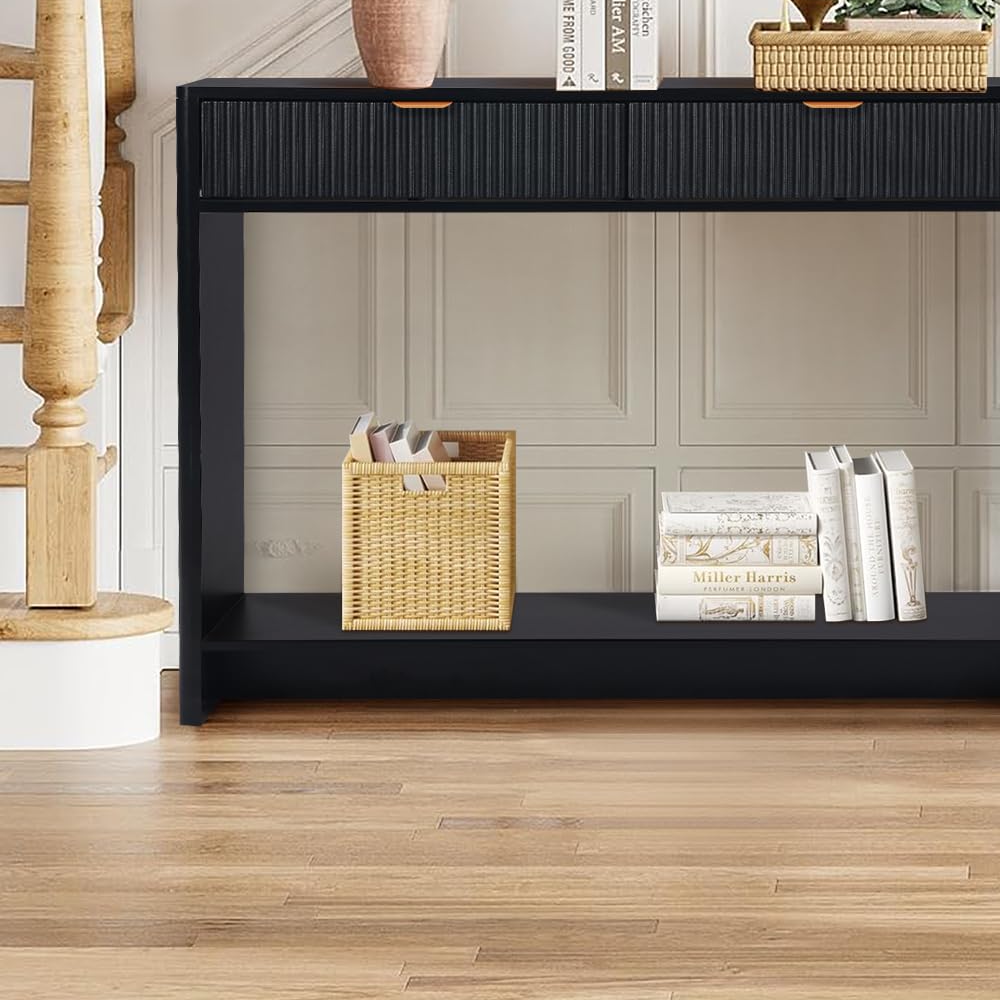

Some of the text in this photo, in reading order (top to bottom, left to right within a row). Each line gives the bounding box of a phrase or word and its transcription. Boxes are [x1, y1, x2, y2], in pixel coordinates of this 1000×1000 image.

[562, 15, 575, 43] FROM
[611, 25, 626, 53] AM
[562, 46, 575, 73] GOOD
[693, 571, 797, 583] Miller Harris
